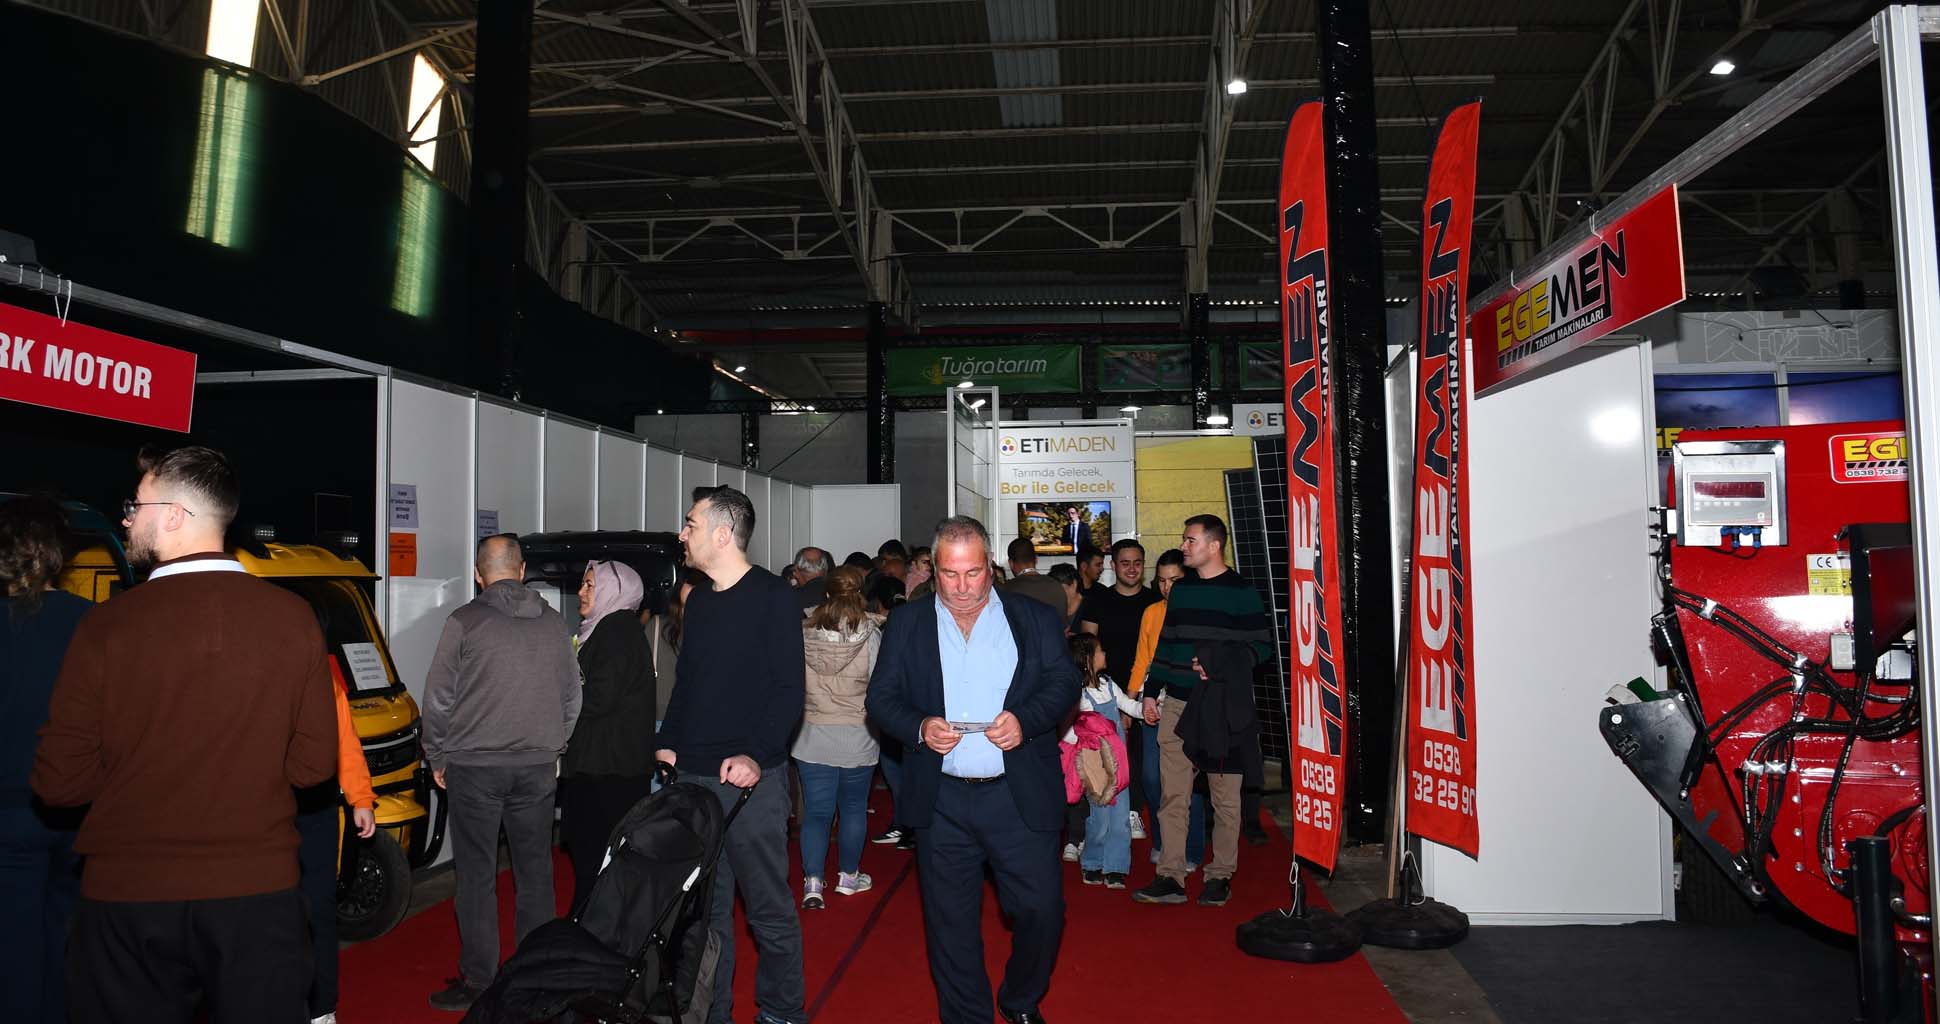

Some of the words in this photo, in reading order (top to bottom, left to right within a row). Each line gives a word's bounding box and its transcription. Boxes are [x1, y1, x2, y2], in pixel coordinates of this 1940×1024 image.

[1496, 229, 1626, 352] EGEMEN
[1535, 333, 1556, 350] TARIM
[1557, 308, 1604, 340] MAKİNALARI
[43, 344, 152, 399] MOTOR
[1013, 468, 1054, 478] Tarımda
[1284, 200, 1326, 753] EGEMEN
[1419, 197, 1460, 734] EGEMEN
[1846, 469, 1875, 477] 0538
[1000, 482, 1027, 494] Bor
[1032, 482, 1049, 493] ile
[1054, 480, 1115, 493] Gelecek
[1423, 740, 1462, 776] 0538
[1301, 759, 1336, 796] 0538
[1437, 778, 1459, 811] 25
[1313, 798, 1333, 831] 25
